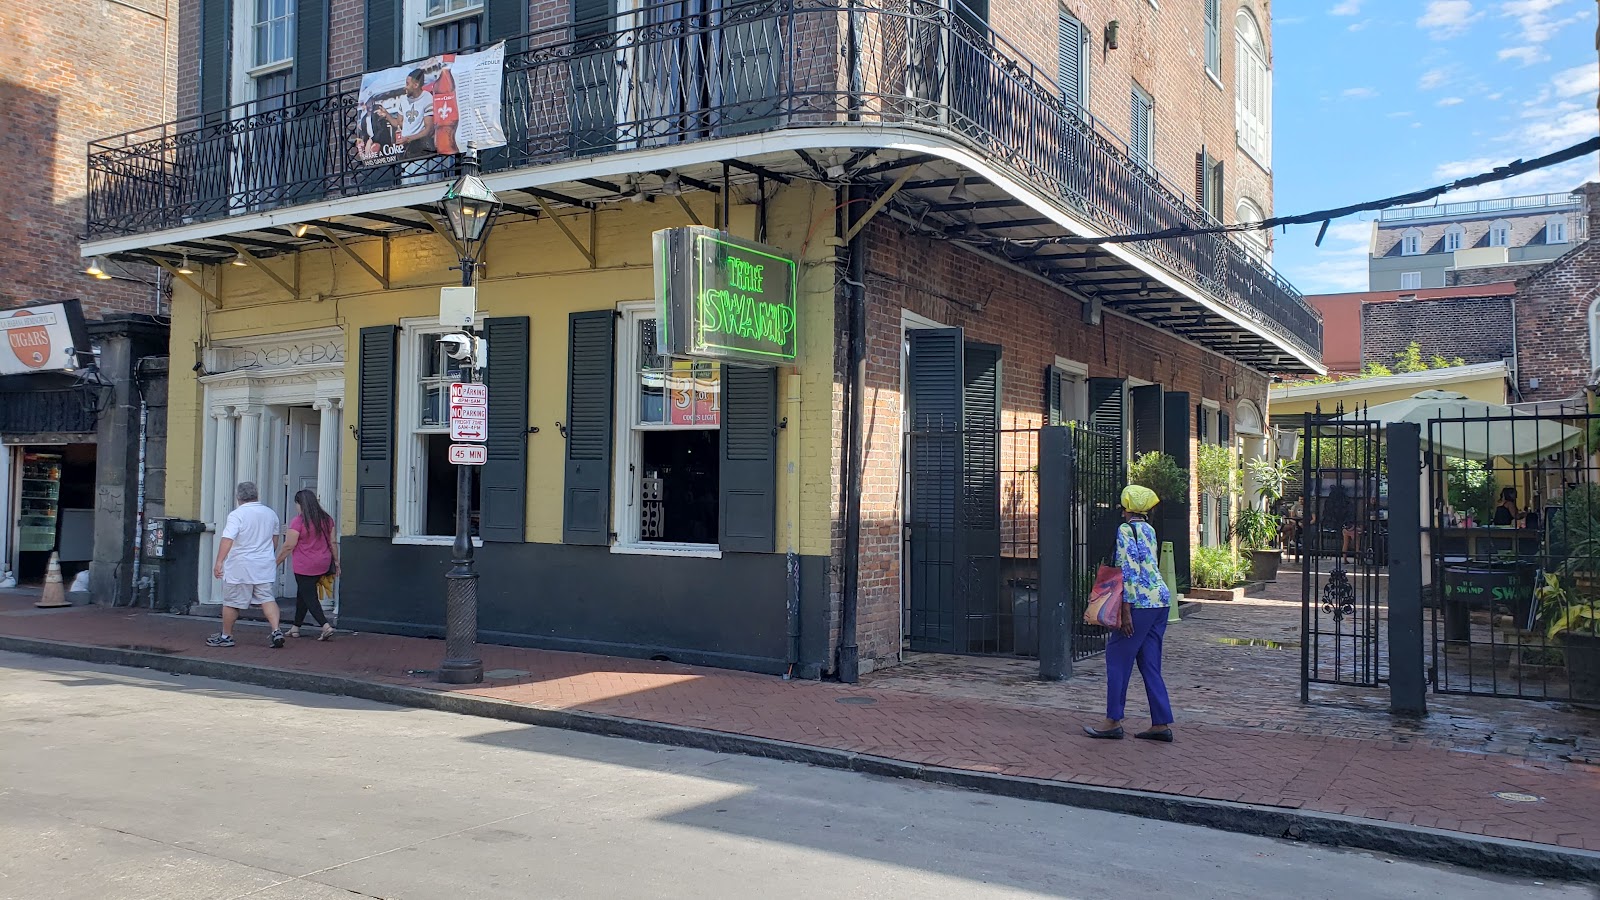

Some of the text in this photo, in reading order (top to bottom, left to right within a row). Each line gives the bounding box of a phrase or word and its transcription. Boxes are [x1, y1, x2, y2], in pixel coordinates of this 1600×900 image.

[383, 143, 405, 156] Coke
[727, 255, 763, 293] THE
[703, 289, 794, 346] SWAMP
[9, 330, 48, 348] CIGARS
[452, 386, 485, 397] NO PARKING
[675, 379, 691, 409] 3
[710, 378, 720, 411] 1
[452, 408, 485, 418] NO PARKING
[455, 450, 482, 459] 45 MIN
